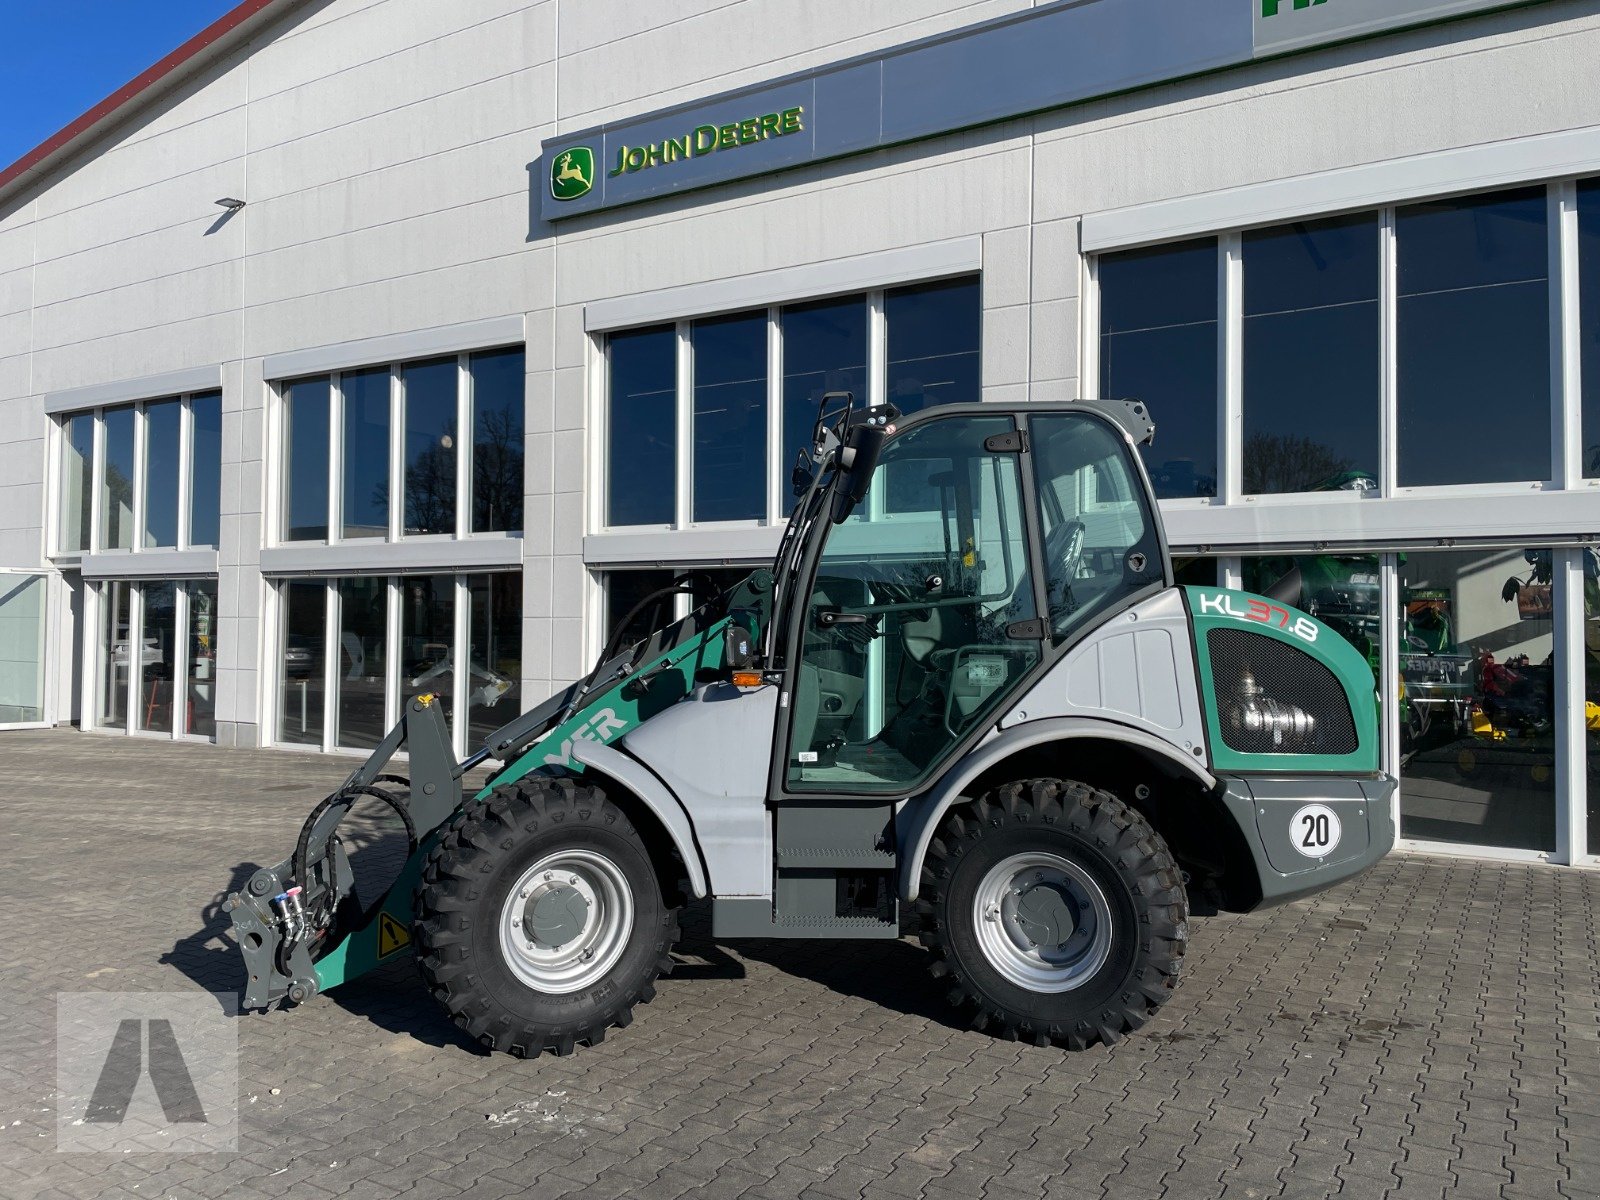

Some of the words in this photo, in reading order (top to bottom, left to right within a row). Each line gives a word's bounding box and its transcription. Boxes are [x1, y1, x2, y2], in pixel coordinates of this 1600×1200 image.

[608, 134, 692, 177] JOHN
[694, 105, 804, 156] DEERE
[1302, 814, 1329, 847] 20
